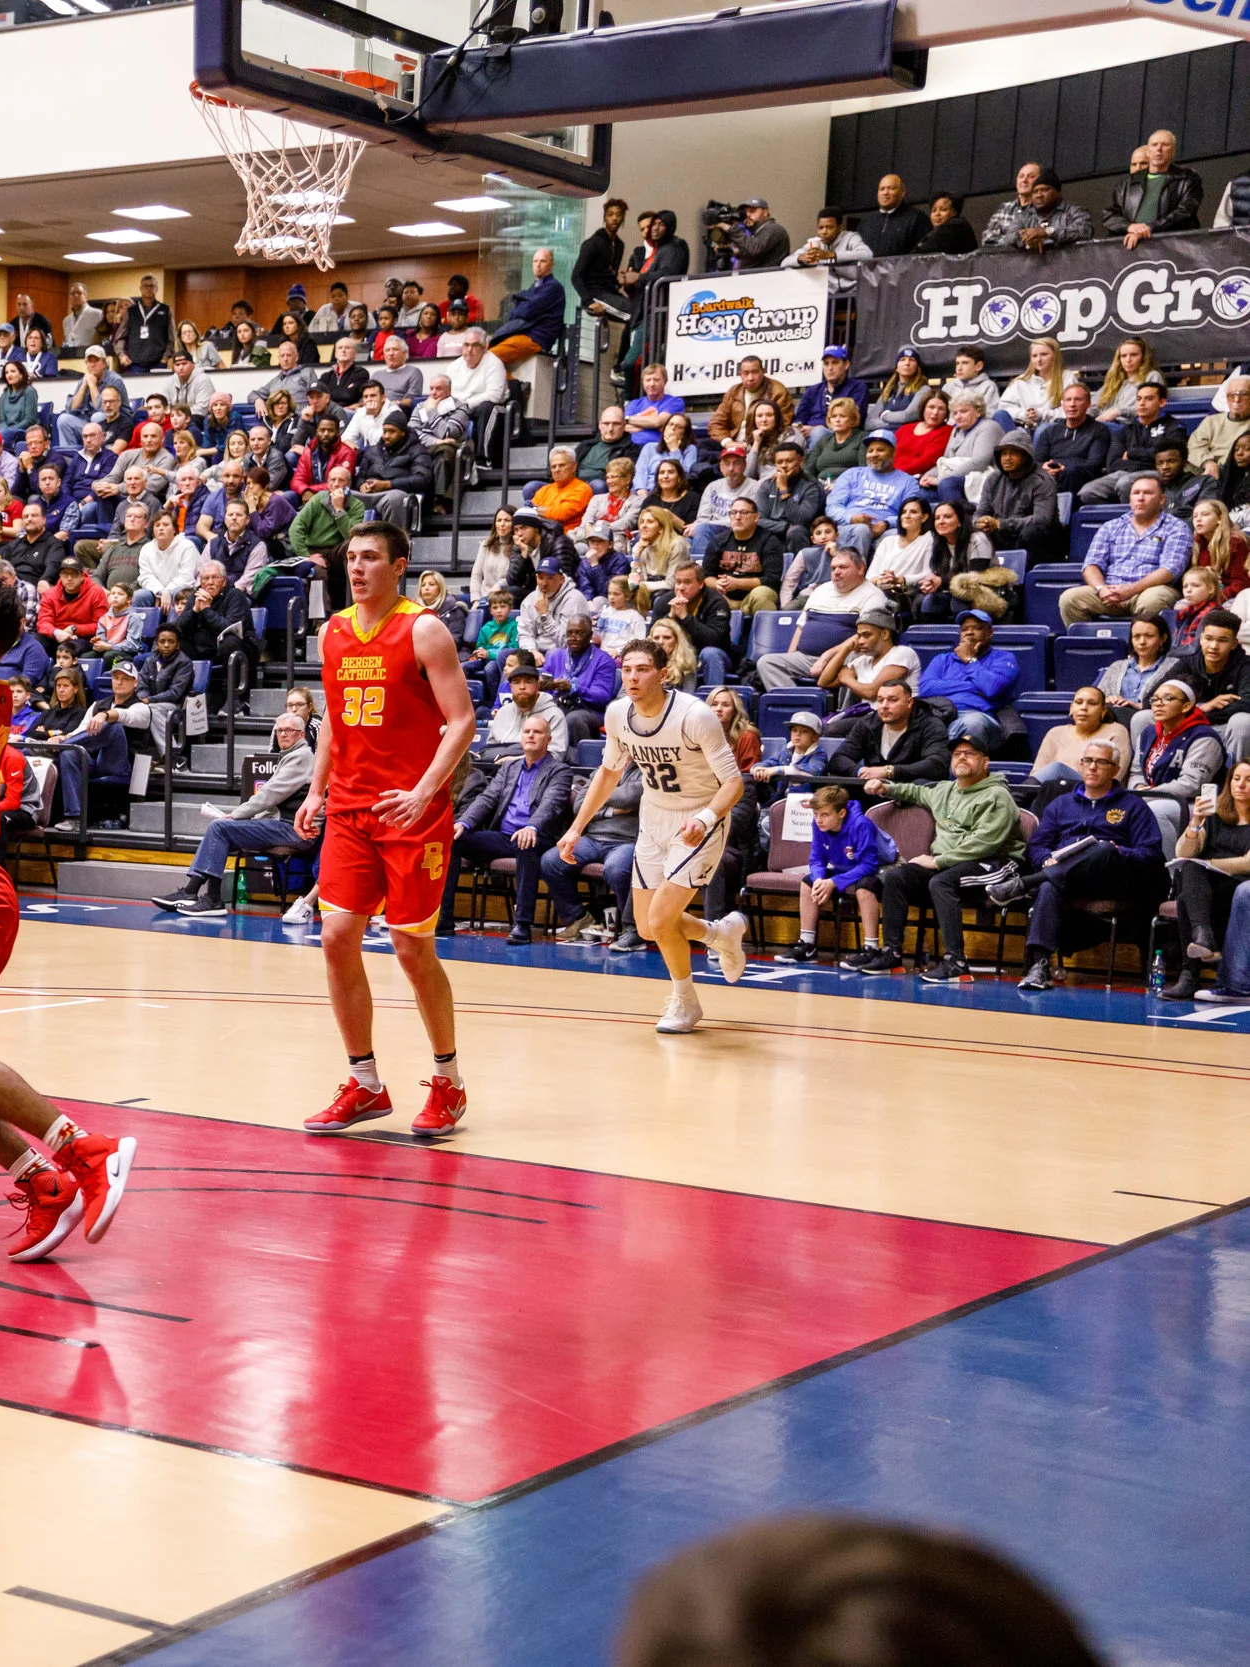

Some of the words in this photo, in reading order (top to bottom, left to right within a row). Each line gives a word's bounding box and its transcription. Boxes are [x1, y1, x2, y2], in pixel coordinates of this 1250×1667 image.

[691, 297, 754, 315] Boardwalk
[917, 284, 1107, 342] Hoop
[677, 313, 740, 337] Hoop
[741, 306, 818, 330] Group
[735, 325, 812, 346] Showcase
[336, 668, 387, 681] CATHOLIC
[341, 656, 383, 669] BERGEN
[341, 686, 385, 726] 32
[639, 762, 682, 792] 32
